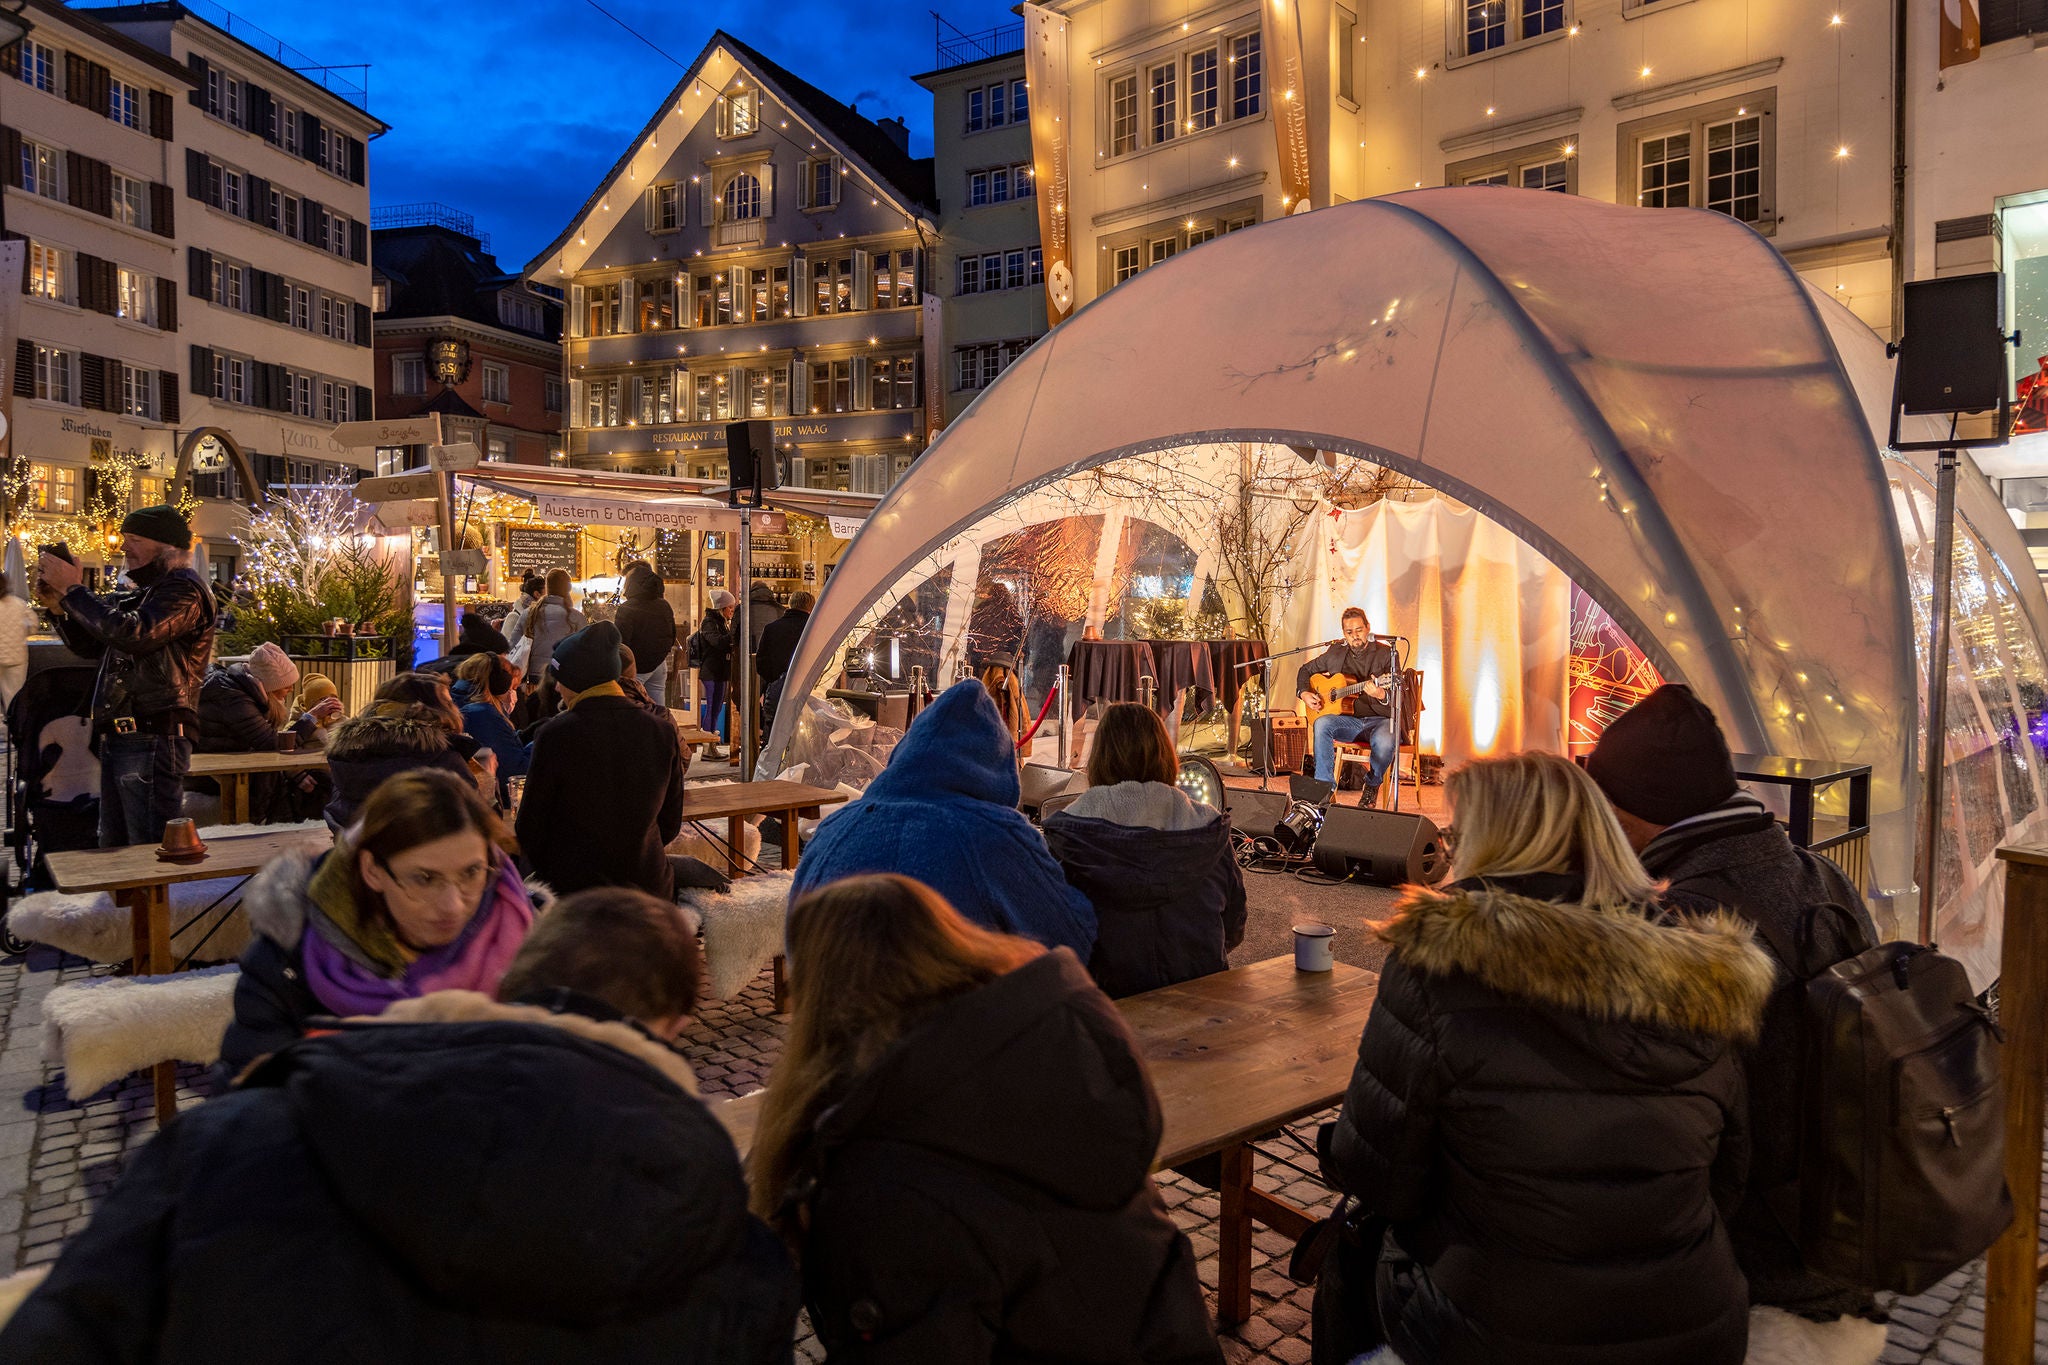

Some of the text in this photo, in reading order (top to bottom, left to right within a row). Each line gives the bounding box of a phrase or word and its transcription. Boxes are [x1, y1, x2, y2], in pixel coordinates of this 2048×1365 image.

[652, 424, 828, 443] RESTAURANT ZU ZUR WAAG
[544, 503, 699, 526] Austern & Champagner
[834, 522, 860, 534] Barre
